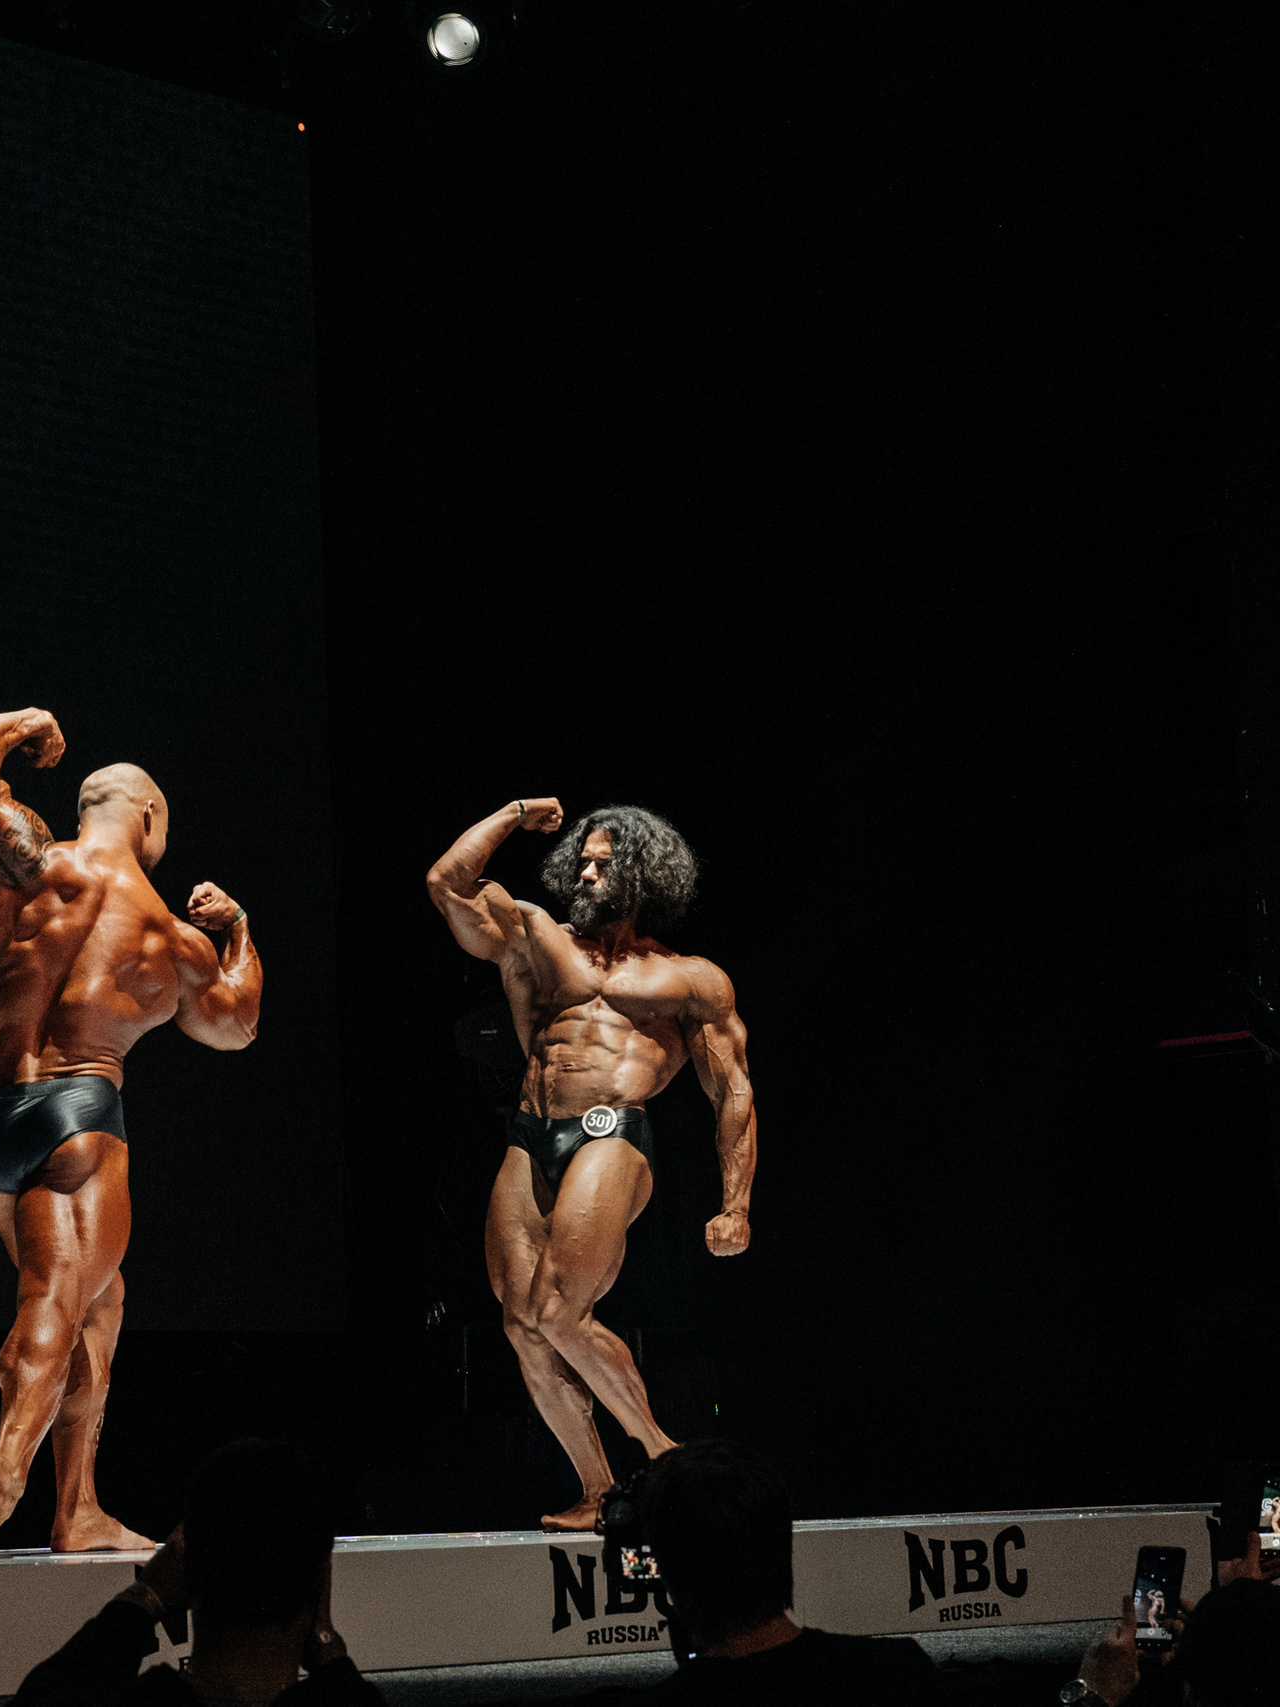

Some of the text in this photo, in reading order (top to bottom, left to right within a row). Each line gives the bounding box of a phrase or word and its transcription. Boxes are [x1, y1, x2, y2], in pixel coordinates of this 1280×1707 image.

[588, 1113, 611, 1128] 301
[904, 1525, 1028, 1613] NBC
[939, 1602, 1002, 1622] RUSSIA
[587, 1625, 660, 1645] RUSSIA
